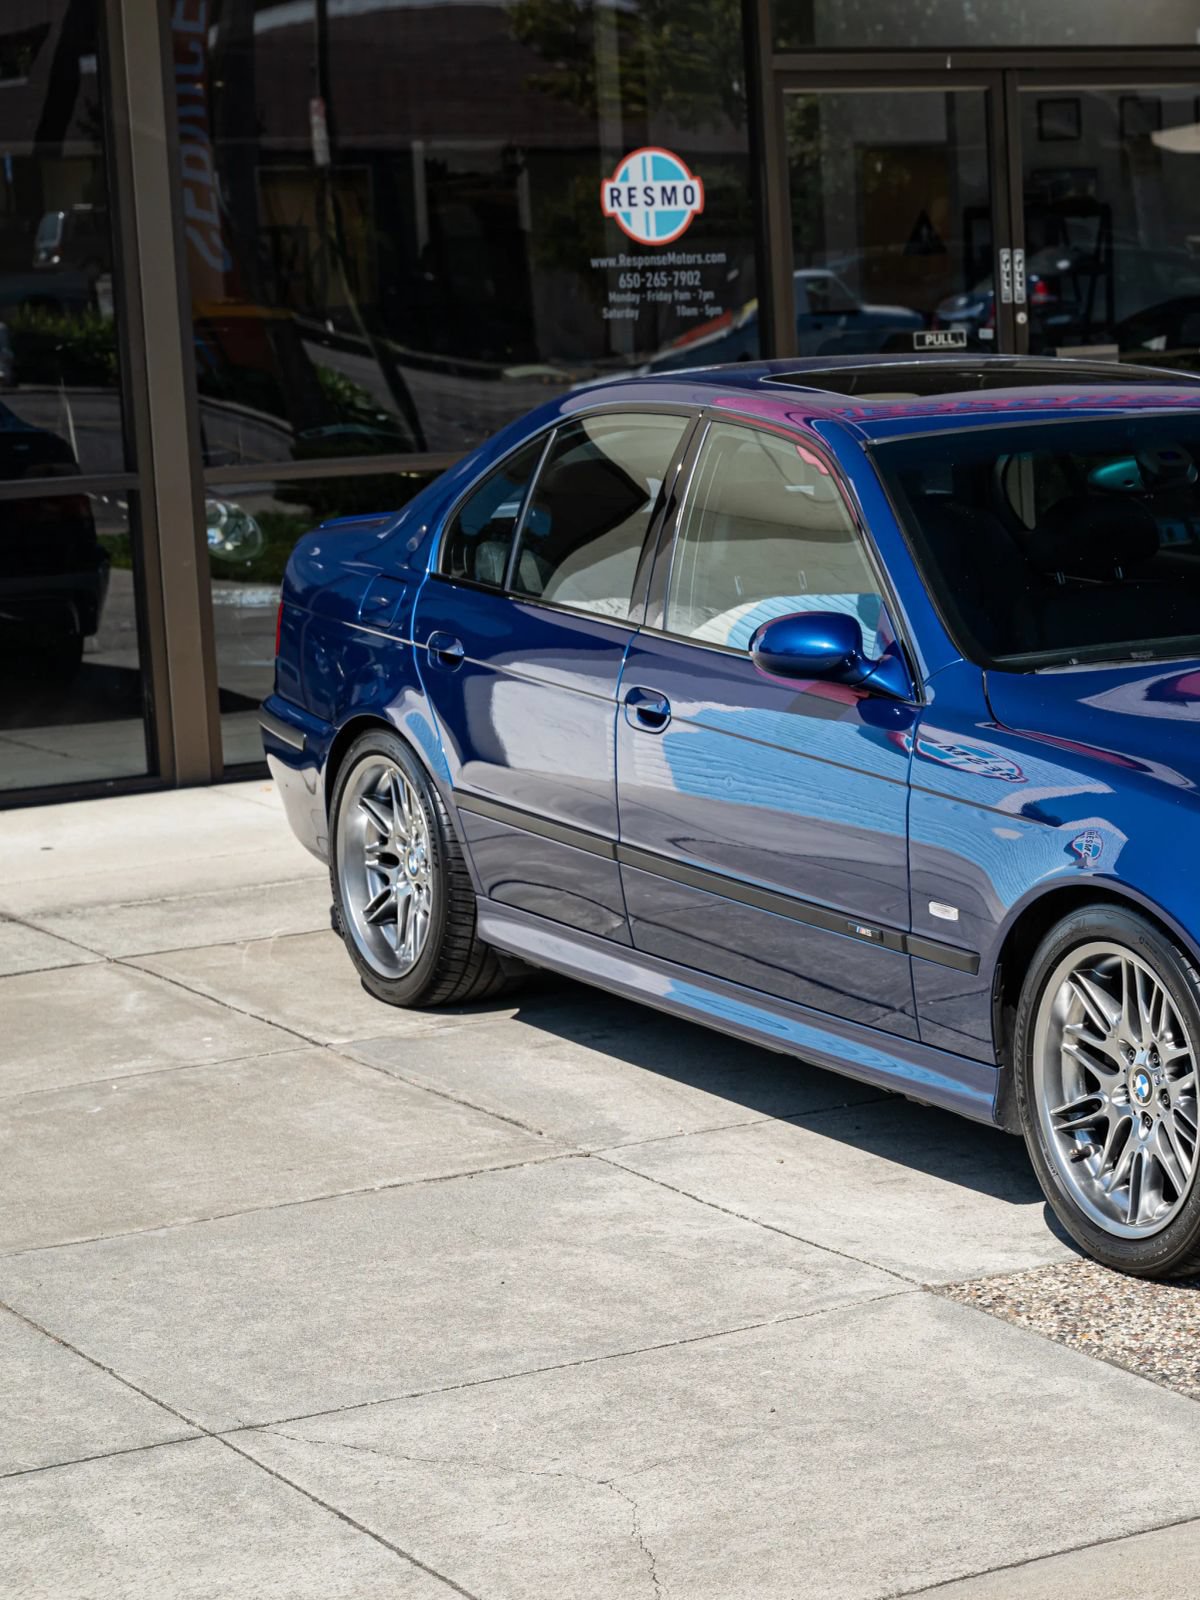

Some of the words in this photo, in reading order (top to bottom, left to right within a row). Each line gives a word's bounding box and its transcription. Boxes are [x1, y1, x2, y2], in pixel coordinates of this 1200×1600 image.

[610, 185, 696, 207] RESMO
[590, 253, 727, 269] www.ResponseMotors.com
[619, 271, 701, 288] 650-265-7902
[608, 291, 640, 304] Monday
[647, 290, 673, 304] Friday
[602, 307, 640, 320] Saturday
[676, 305, 699, 316] 10am
[925, 333, 955, 346] PULL
